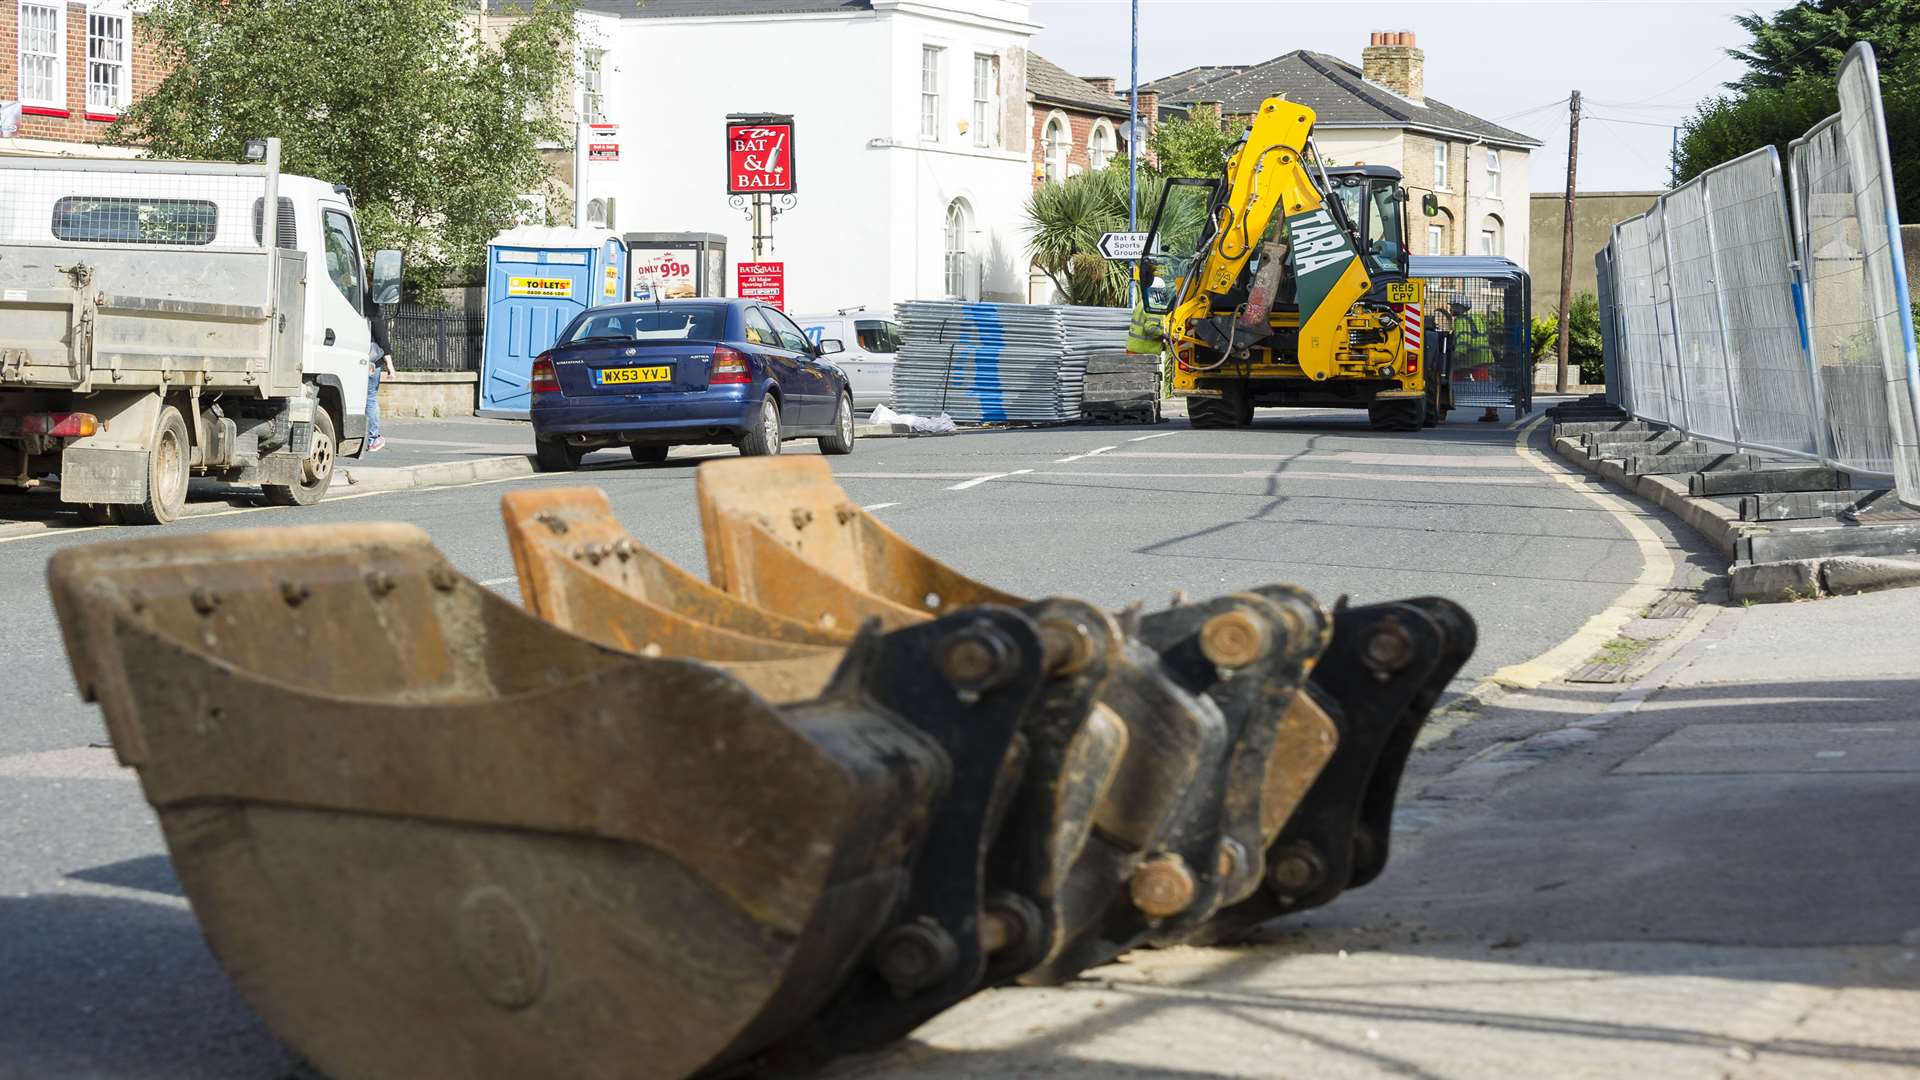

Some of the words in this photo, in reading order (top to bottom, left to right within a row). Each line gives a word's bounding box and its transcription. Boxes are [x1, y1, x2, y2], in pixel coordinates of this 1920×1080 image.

[739, 128, 776, 139] The
[735, 139, 768, 152] BAT
[743, 154, 765, 171] &
[737, 173, 786, 187] BALL
[1290, 210, 1355, 277] TARA
[638, 264, 659, 275] ONLY
[660, 262, 690, 278] 99p
[1391, 283, 1414, 293] RE15
[1393, 292, 1413, 302] CPY
[604, 369, 638, 382] WX53
[640, 368, 669, 380] YVJ
